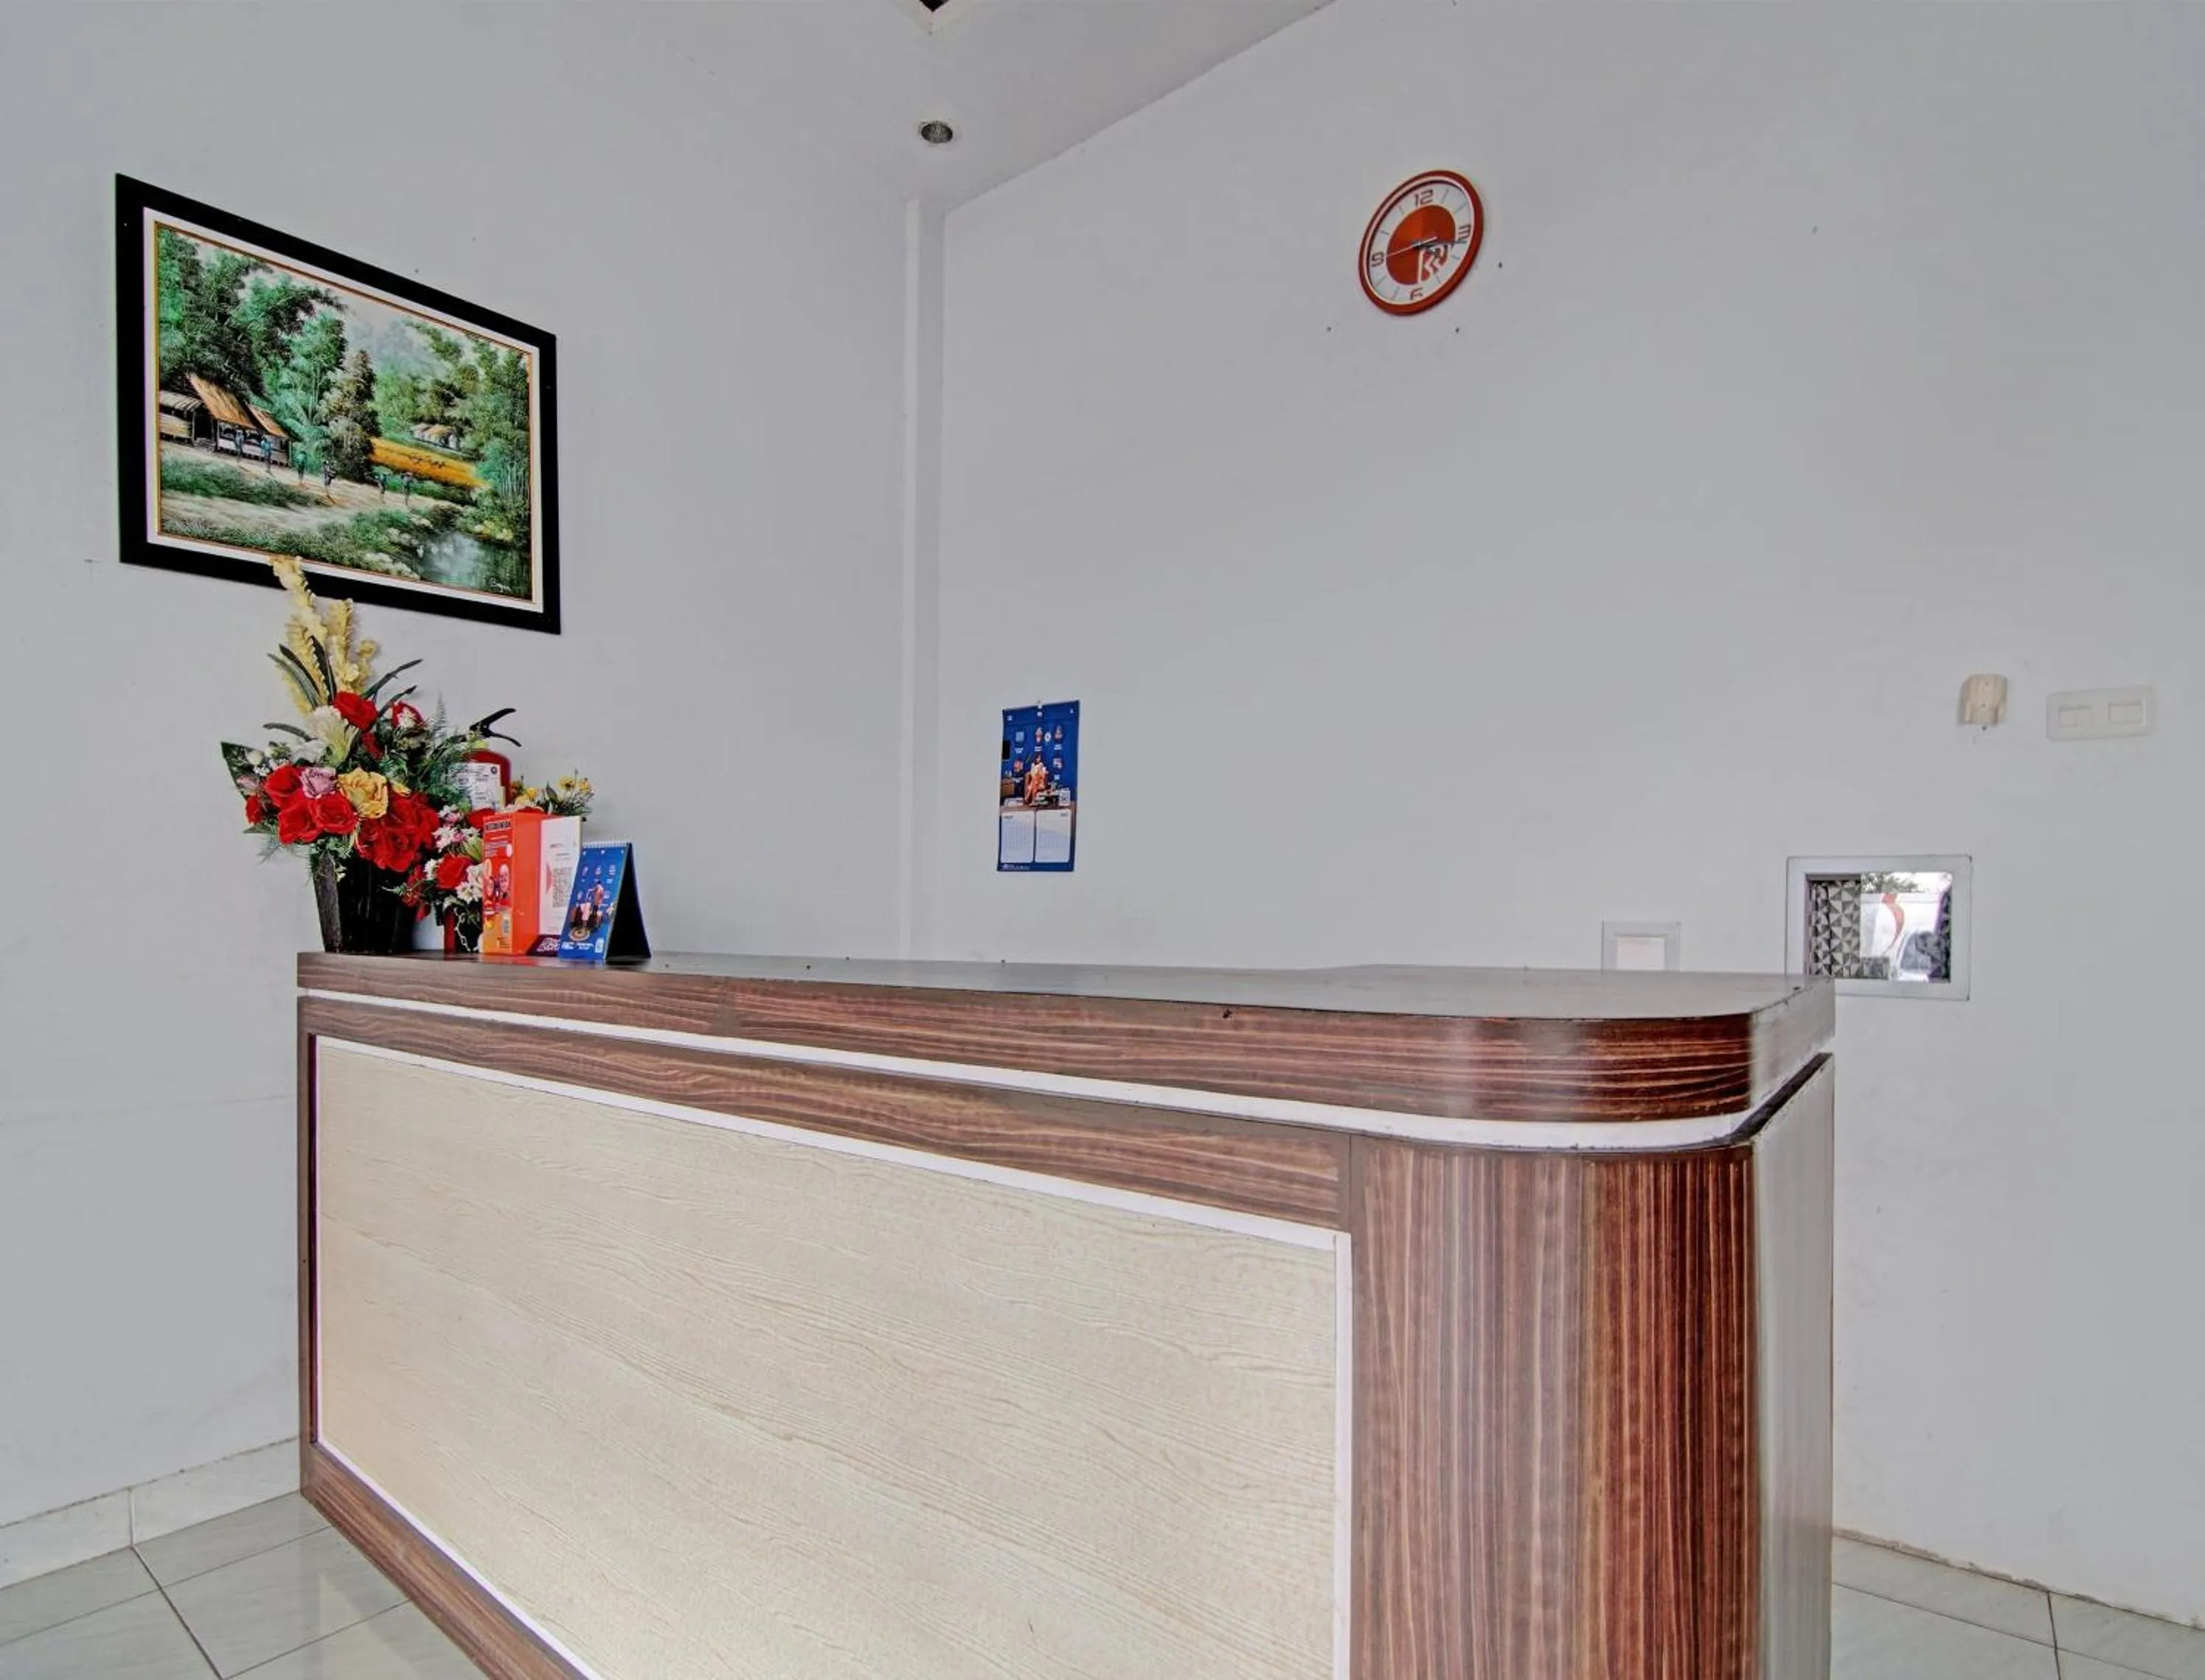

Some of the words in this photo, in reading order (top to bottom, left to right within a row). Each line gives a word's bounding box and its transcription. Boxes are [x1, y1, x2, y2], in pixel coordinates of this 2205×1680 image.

[1414, 190, 1434, 207] 12
[1457, 224, 1471, 242] 3
[1371, 251, 1384, 267] 9
